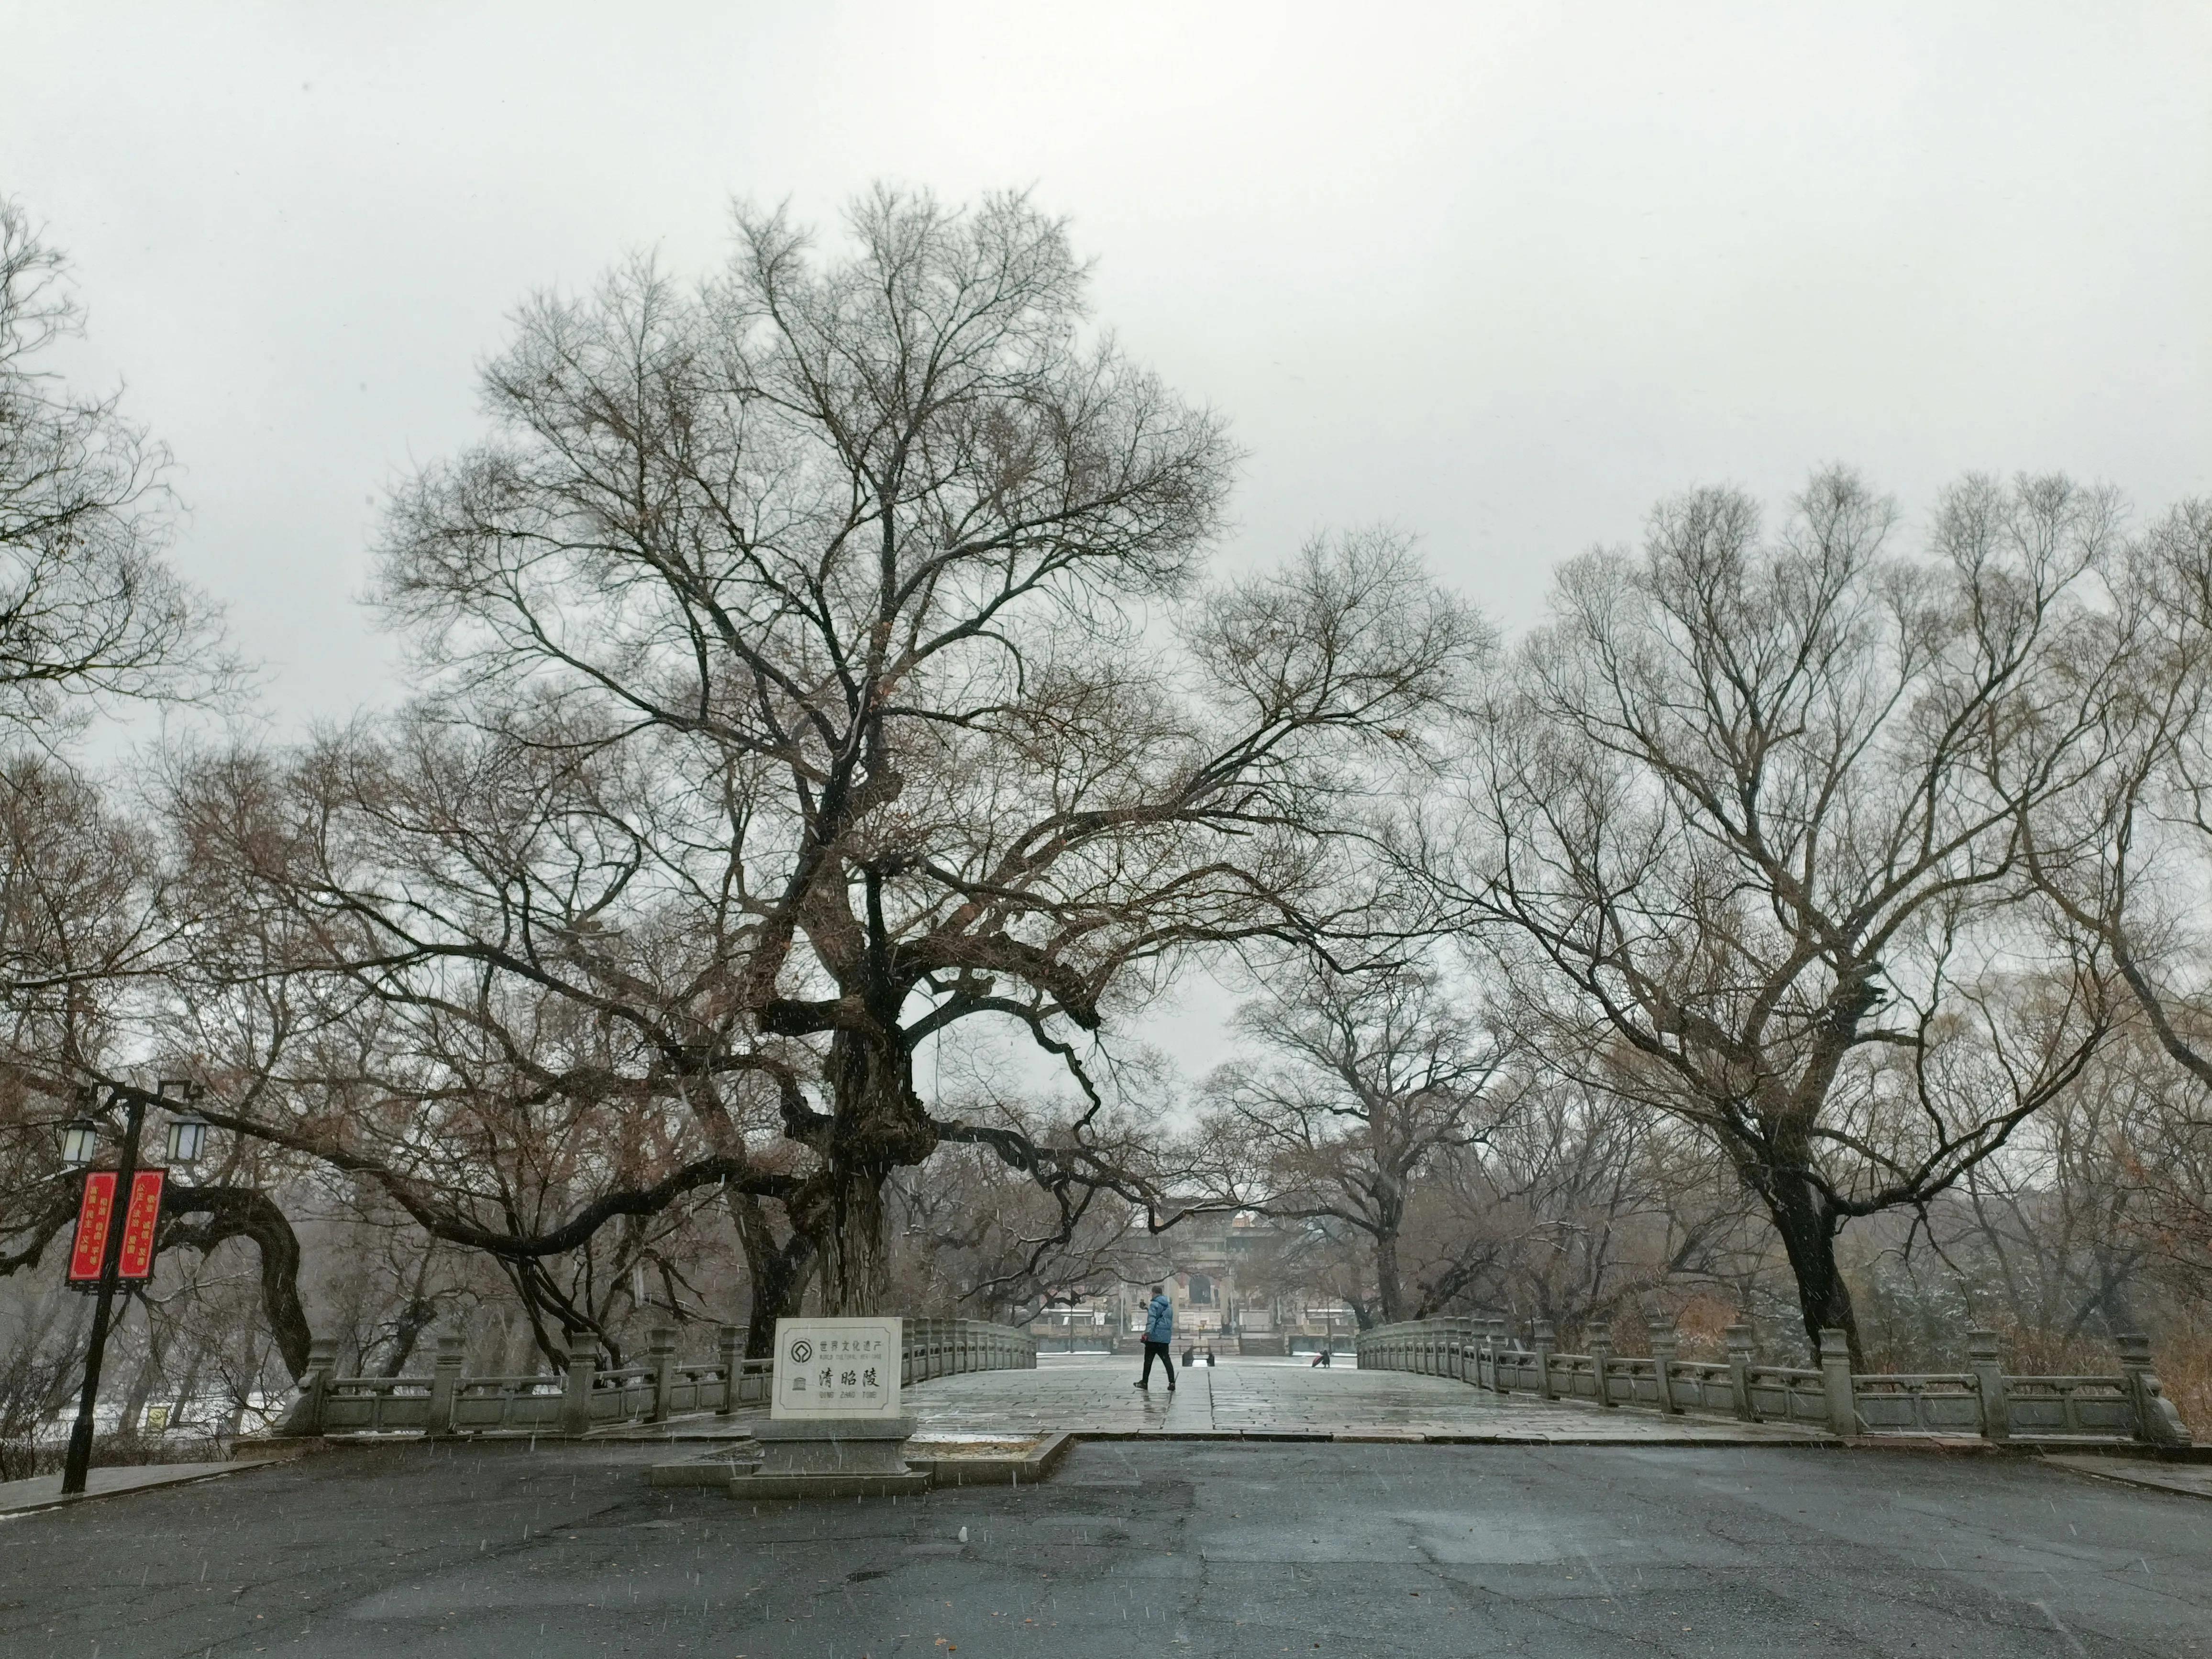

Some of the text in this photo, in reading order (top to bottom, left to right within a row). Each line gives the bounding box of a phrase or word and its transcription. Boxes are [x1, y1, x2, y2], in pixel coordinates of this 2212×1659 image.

[819, 1340, 881, 1351] 世界文化遗产
[819, 1367, 880, 1388] 清昭陵
